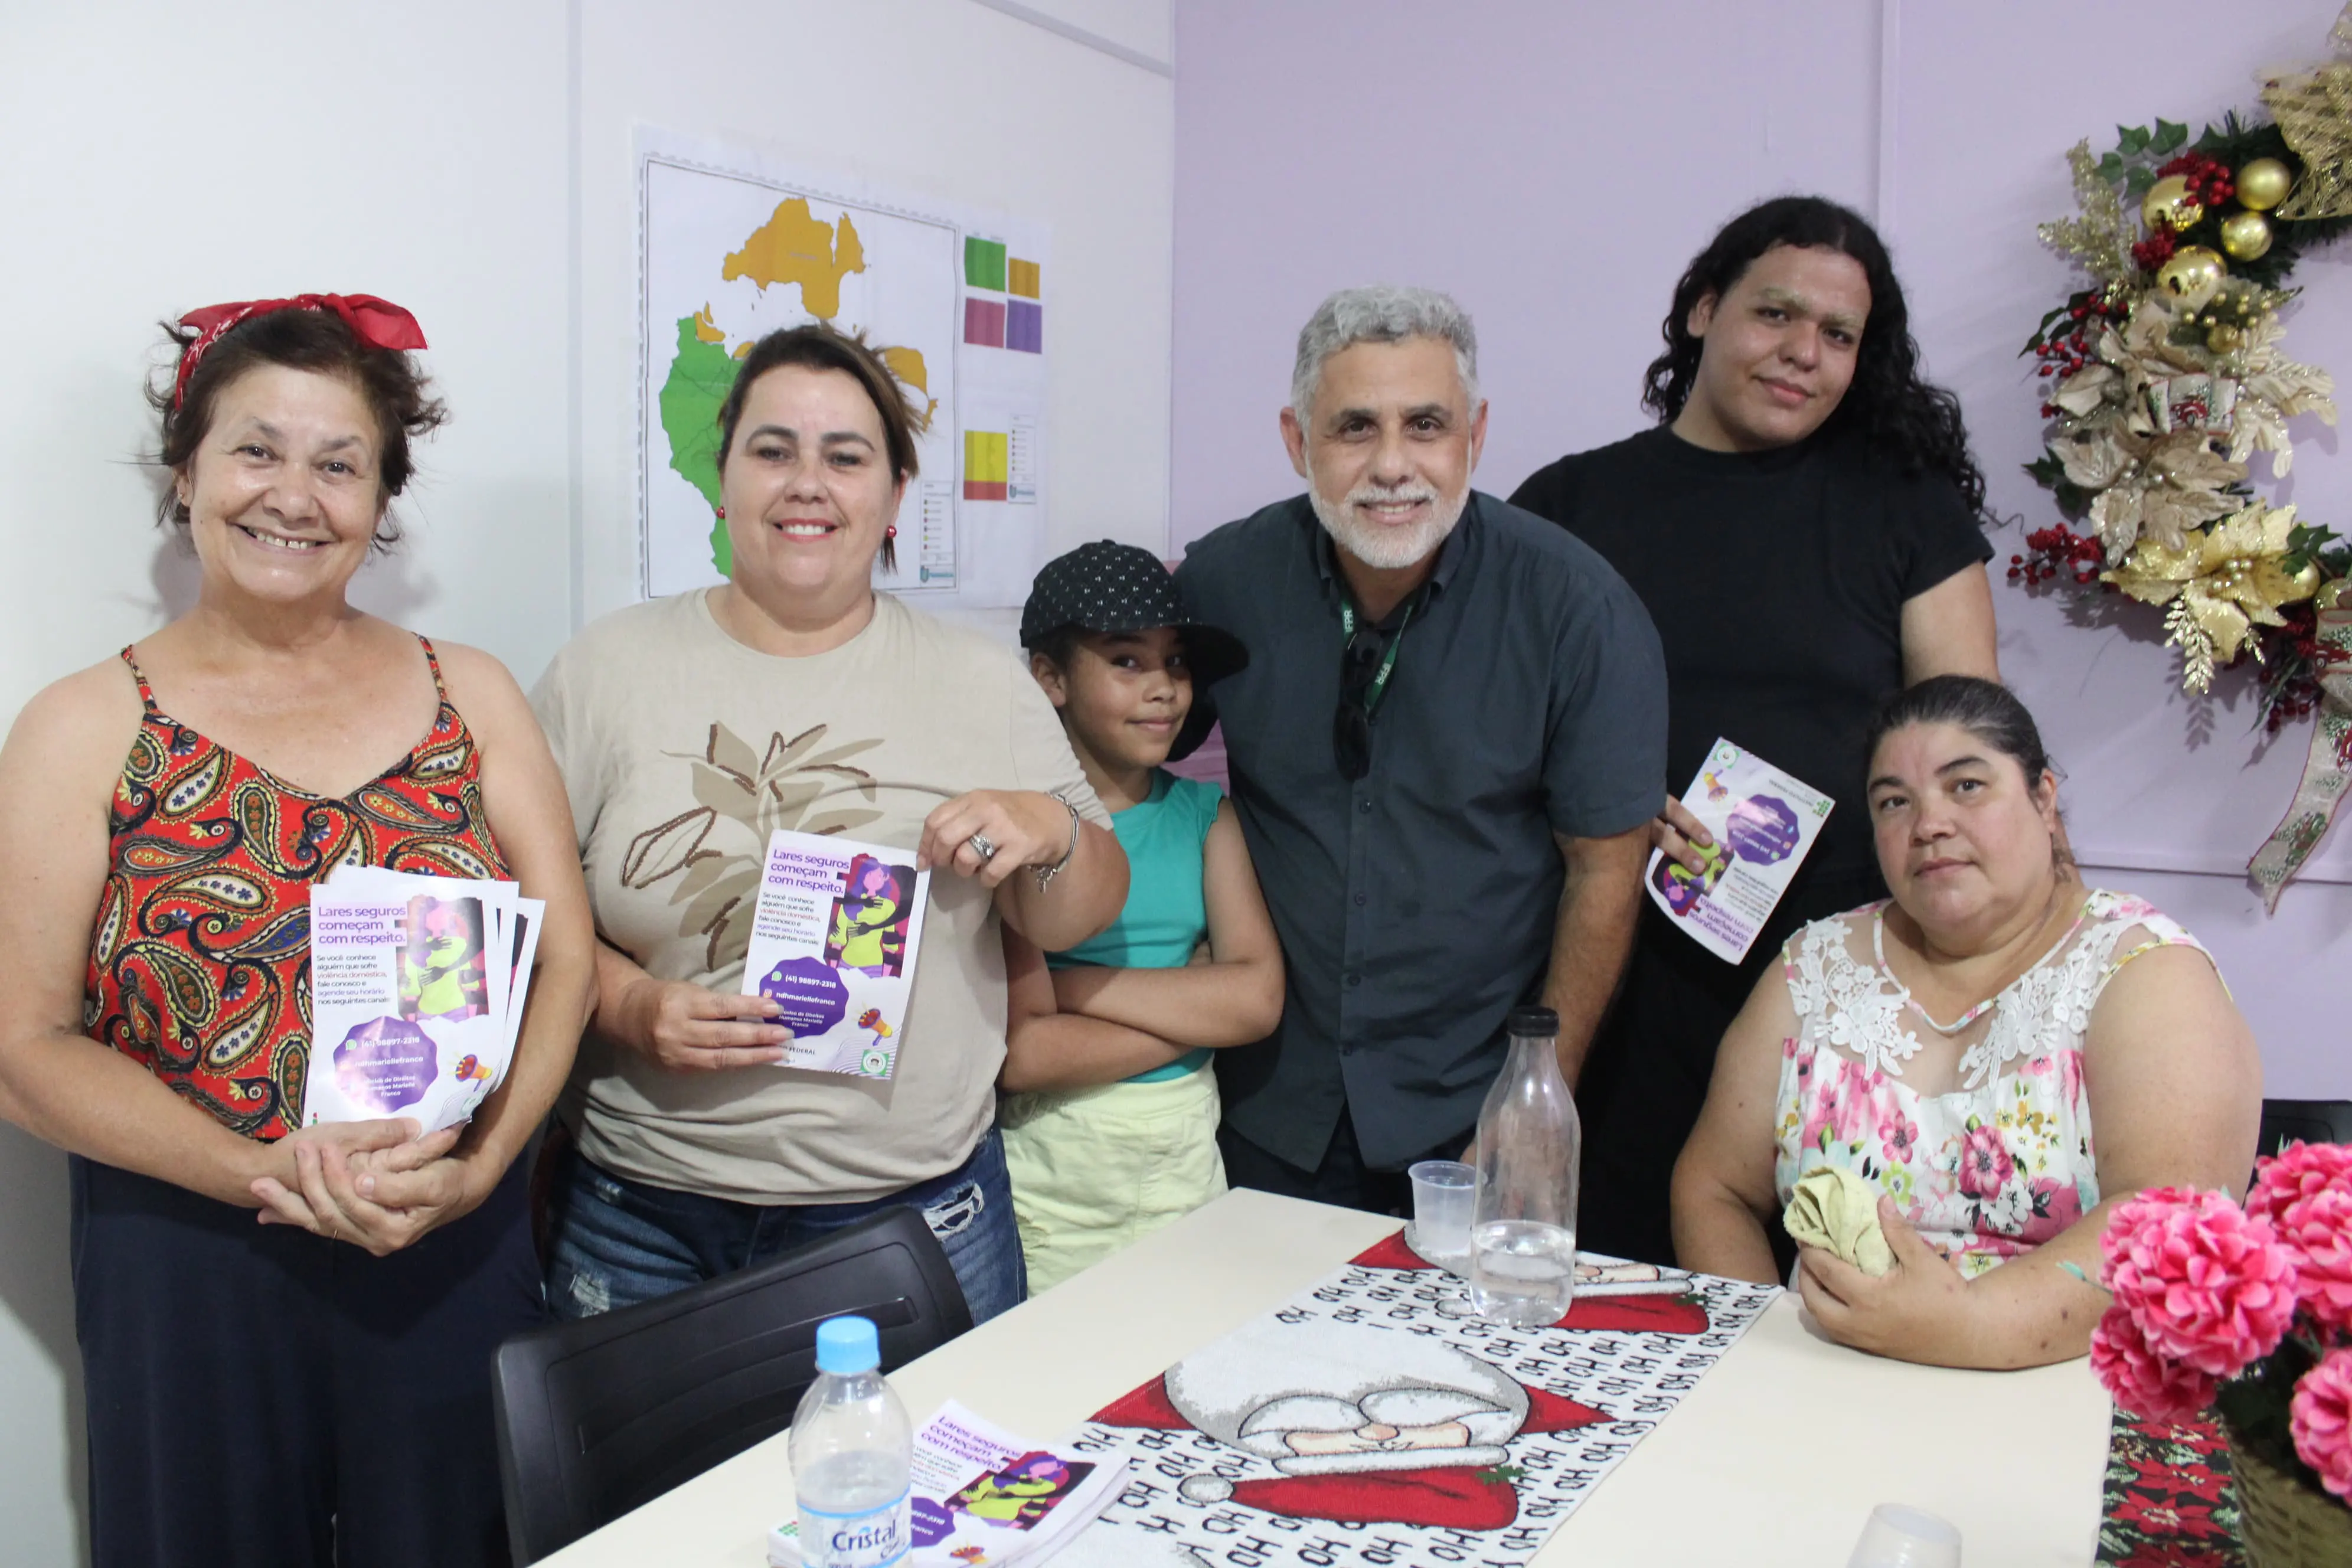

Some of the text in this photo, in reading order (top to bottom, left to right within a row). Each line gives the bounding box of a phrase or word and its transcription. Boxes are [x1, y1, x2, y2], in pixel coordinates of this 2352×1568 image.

[773, 849, 850, 869] Lares seguros
[771, 863, 827, 878] começam
[769, 875, 844, 894] com respeito.
[762, 900, 785, 908] alguém
[319, 907, 406, 919] Lares seguros
[319, 922, 384, 933] começam
[1690, 911, 1743, 951] Lares seguros
[1707, 913, 1749, 942] começam
[1734, 919, 1753, 934] com
[319, 931, 406, 945] com respeito.
[785, 974, 797, 984] (41)
[332, 997, 366, 1006] seguintes
[789, 1046, 815, 1055] FEDERAL
[930, 1425, 991, 1457] começam
[939, 1416, 1021, 1458] Lares seguros
[922, 1433, 949, 1449] com
[950, 1447, 1001, 1470] respeito.
[832, 1519, 896, 1551] Cristal
